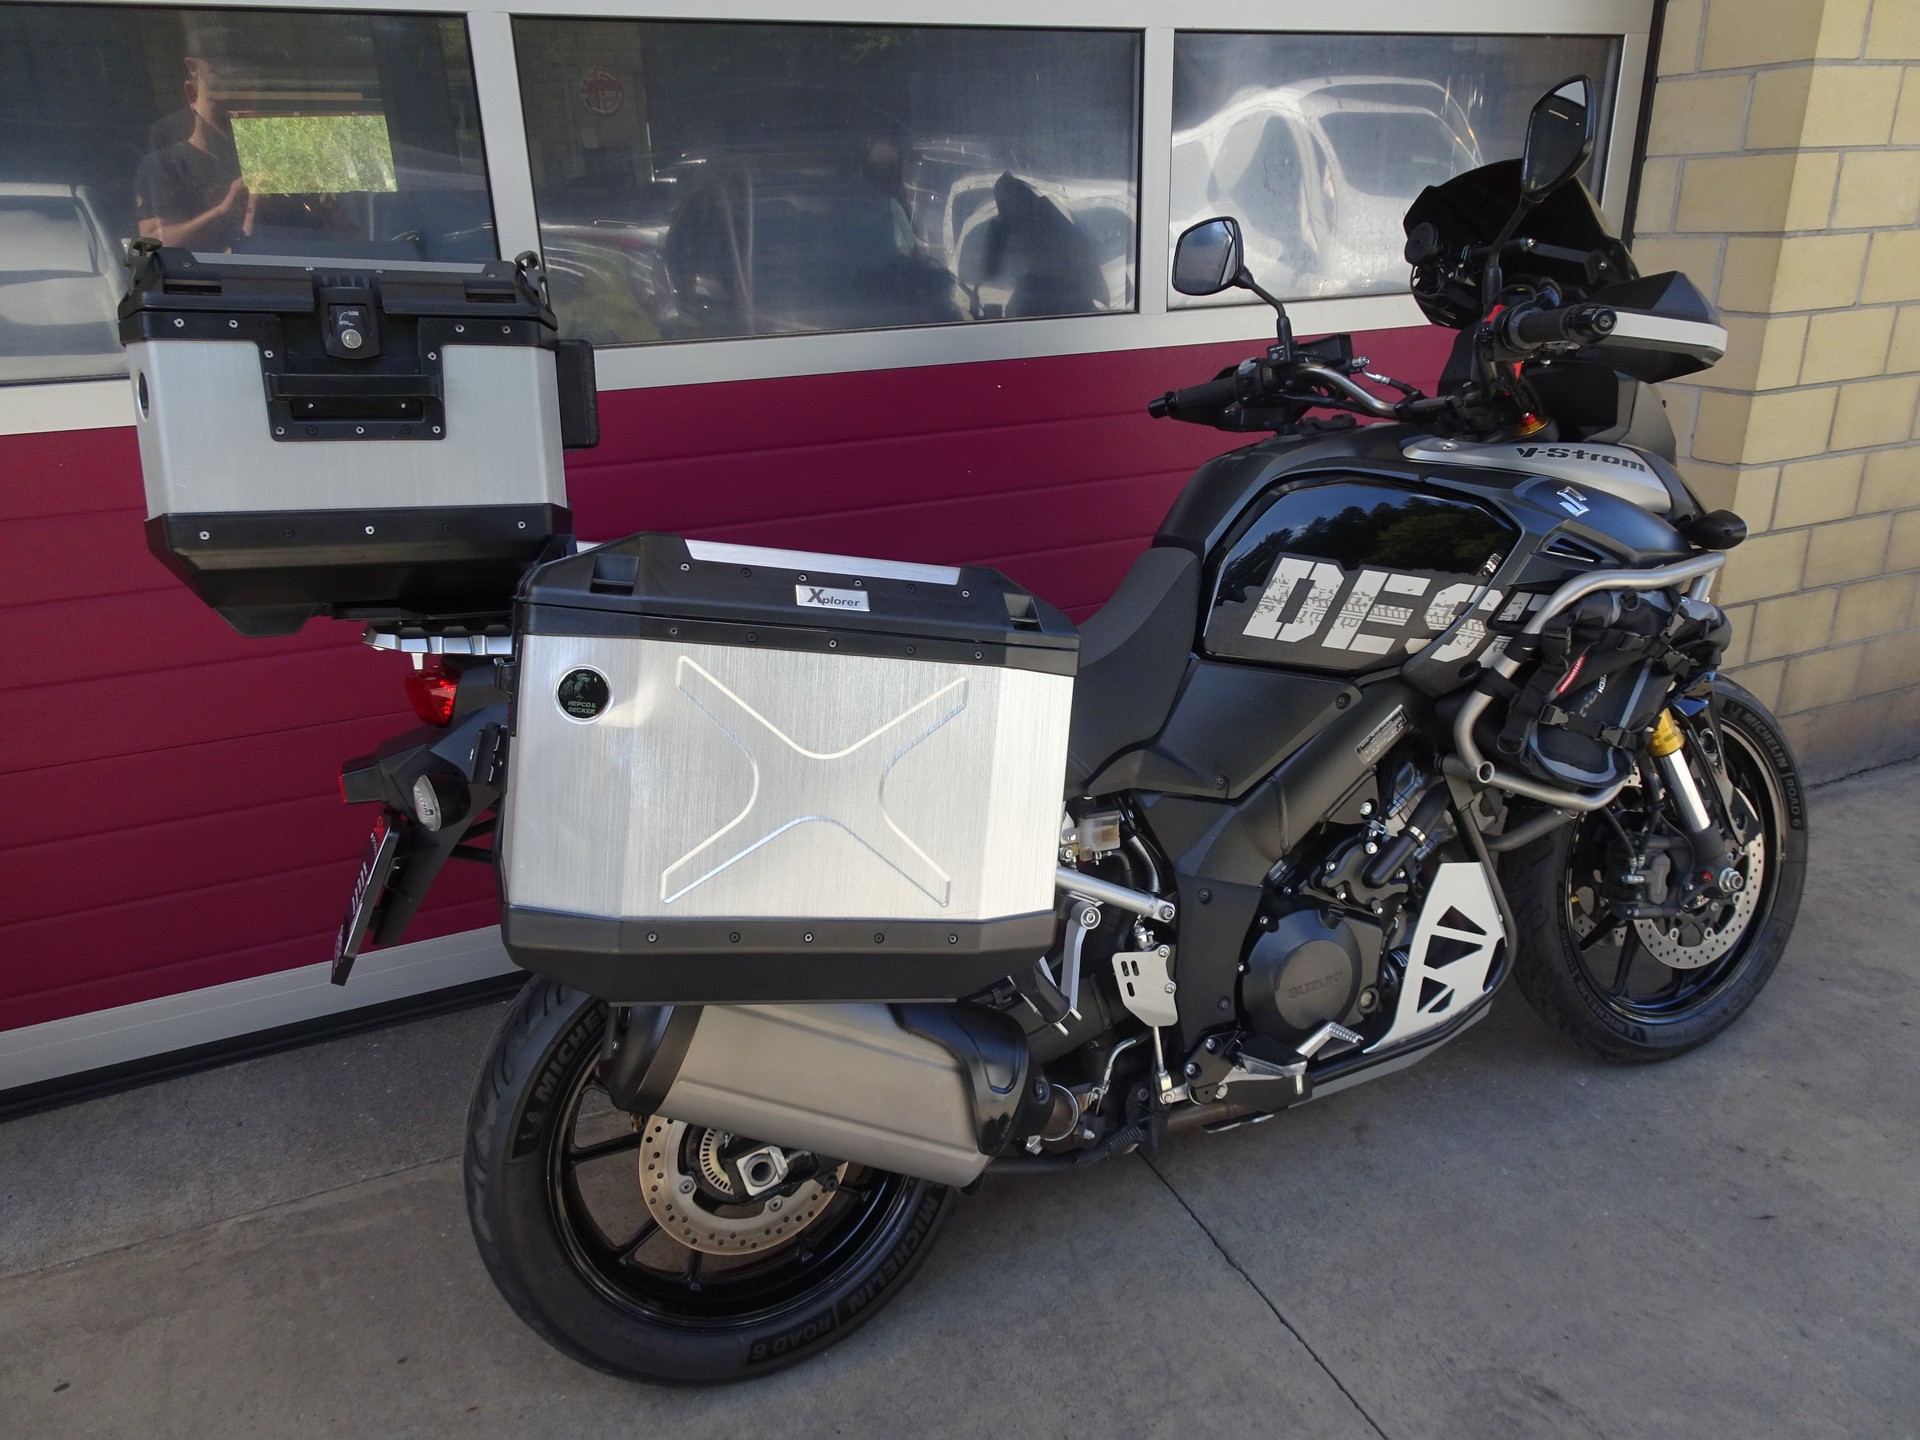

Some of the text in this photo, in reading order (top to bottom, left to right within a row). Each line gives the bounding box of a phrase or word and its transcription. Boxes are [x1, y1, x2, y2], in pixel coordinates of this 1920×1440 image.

[1516, 447, 1646, 472] V-Strom
[807, 587, 861, 607] Xplorer
[567, 700, 591, 708] HEPCO
[567, 706, 596, 715] BECKER
[1744, 712, 1789, 769] MICHELIN
[1785, 778, 1800, 815] ROAD
[1287, 971, 1344, 999] SUZUKI
[1576, 979, 1628, 1034] MICHELIN
[752, 1195, 940, 1358] MICHELIN ROAD 6
